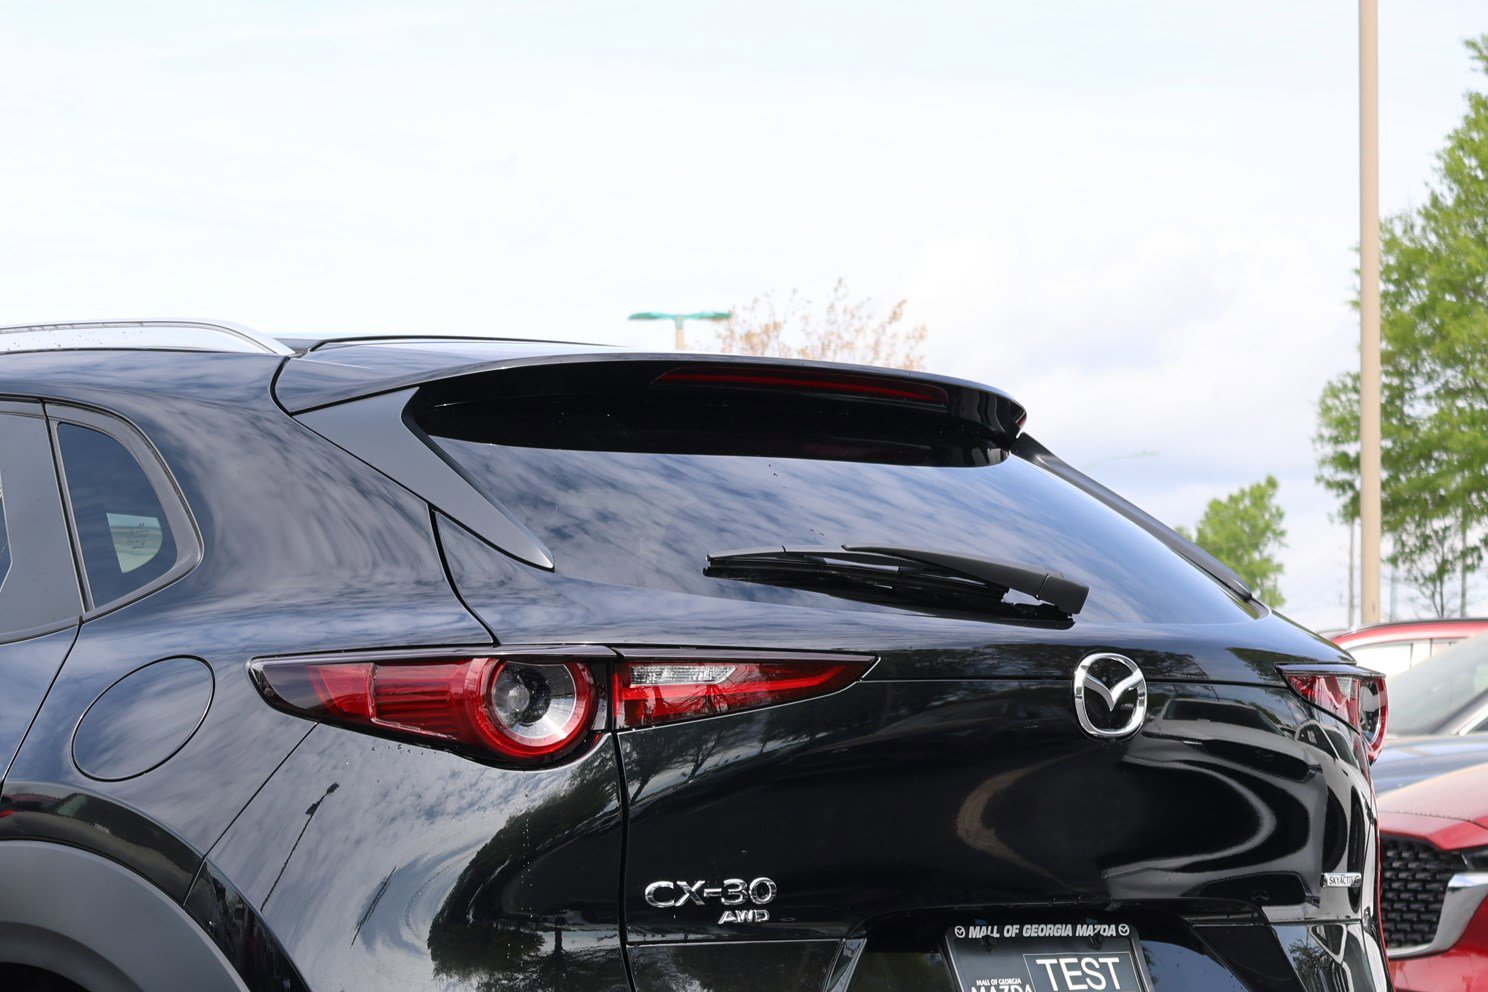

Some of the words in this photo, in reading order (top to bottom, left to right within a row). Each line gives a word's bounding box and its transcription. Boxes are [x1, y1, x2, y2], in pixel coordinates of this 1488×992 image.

[644, 877, 778, 908] CX-30
[717, 909, 770, 924] AWD
[968, 925, 1000, 939] MALL
[1003, 925, 1020, 937] OF
[1022, 924, 1072, 937] GEORGIA
[1075, 924, 1117, 937] MAZDA
[999, 977, 1022, 985] GEORGIA
[1036, 957, 1120, 992] TEST
